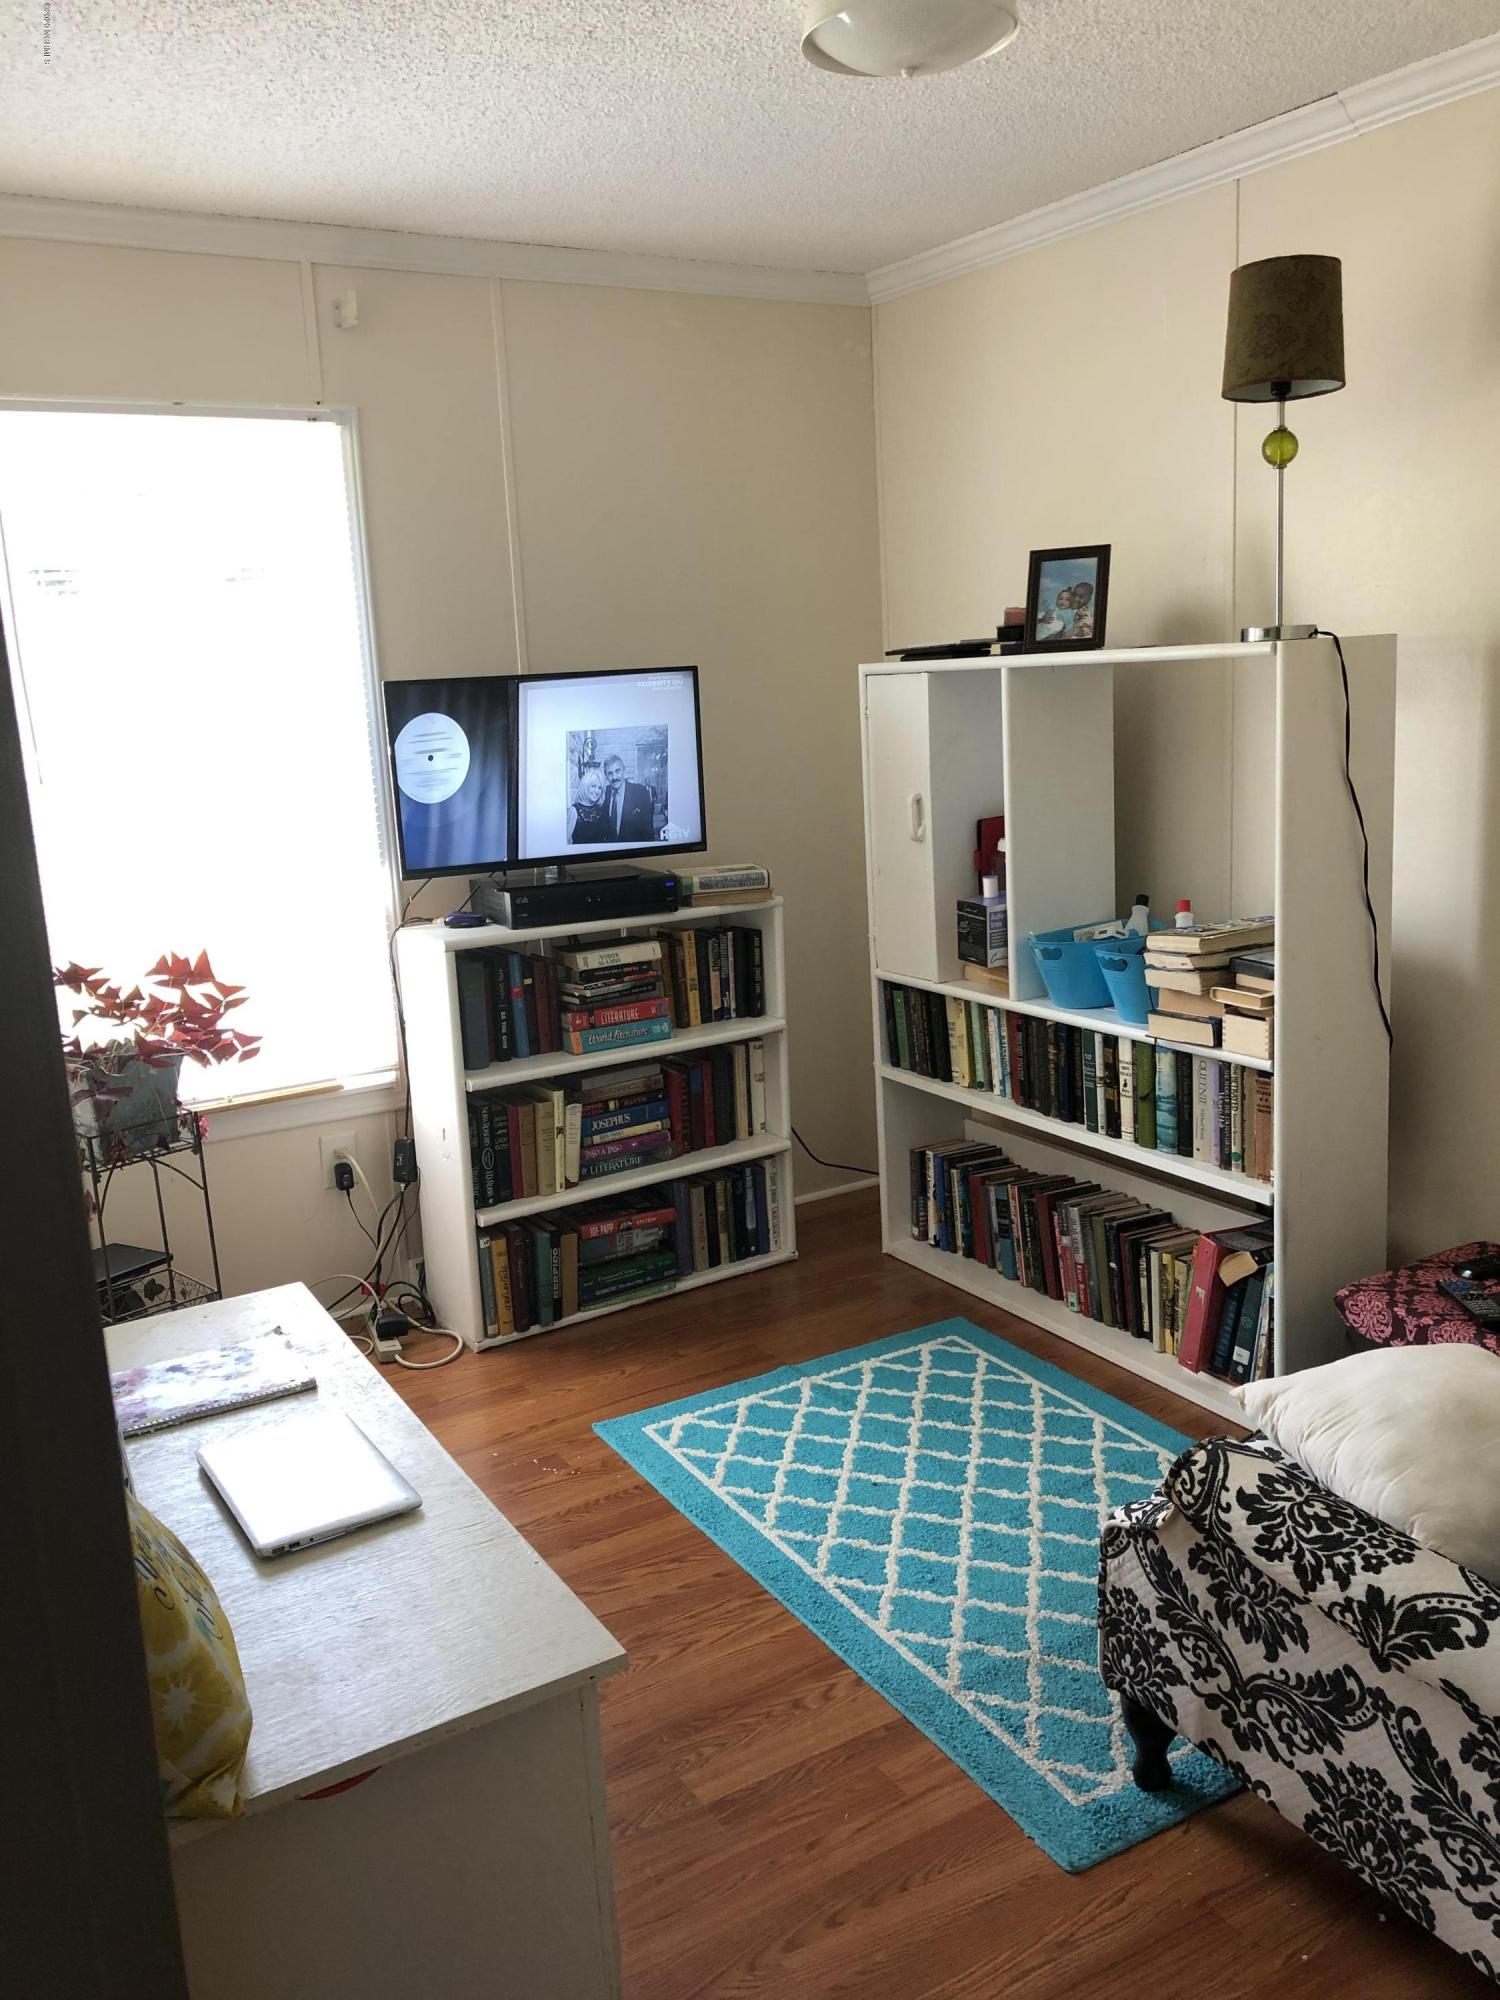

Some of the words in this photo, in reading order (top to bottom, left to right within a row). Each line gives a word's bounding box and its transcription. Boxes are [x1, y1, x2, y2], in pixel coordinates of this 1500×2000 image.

[660, 827, 690, 841] HGTV
[600, 1007, 640, 1025] LITERATURE
[588, 1031, 613, 1045] World
[591, 1113, 631, 1131] JOSEPHUS
[590, 1155, 642, 1175] LITERATURE
[552, 1247, 560, 1299] SERPICO
